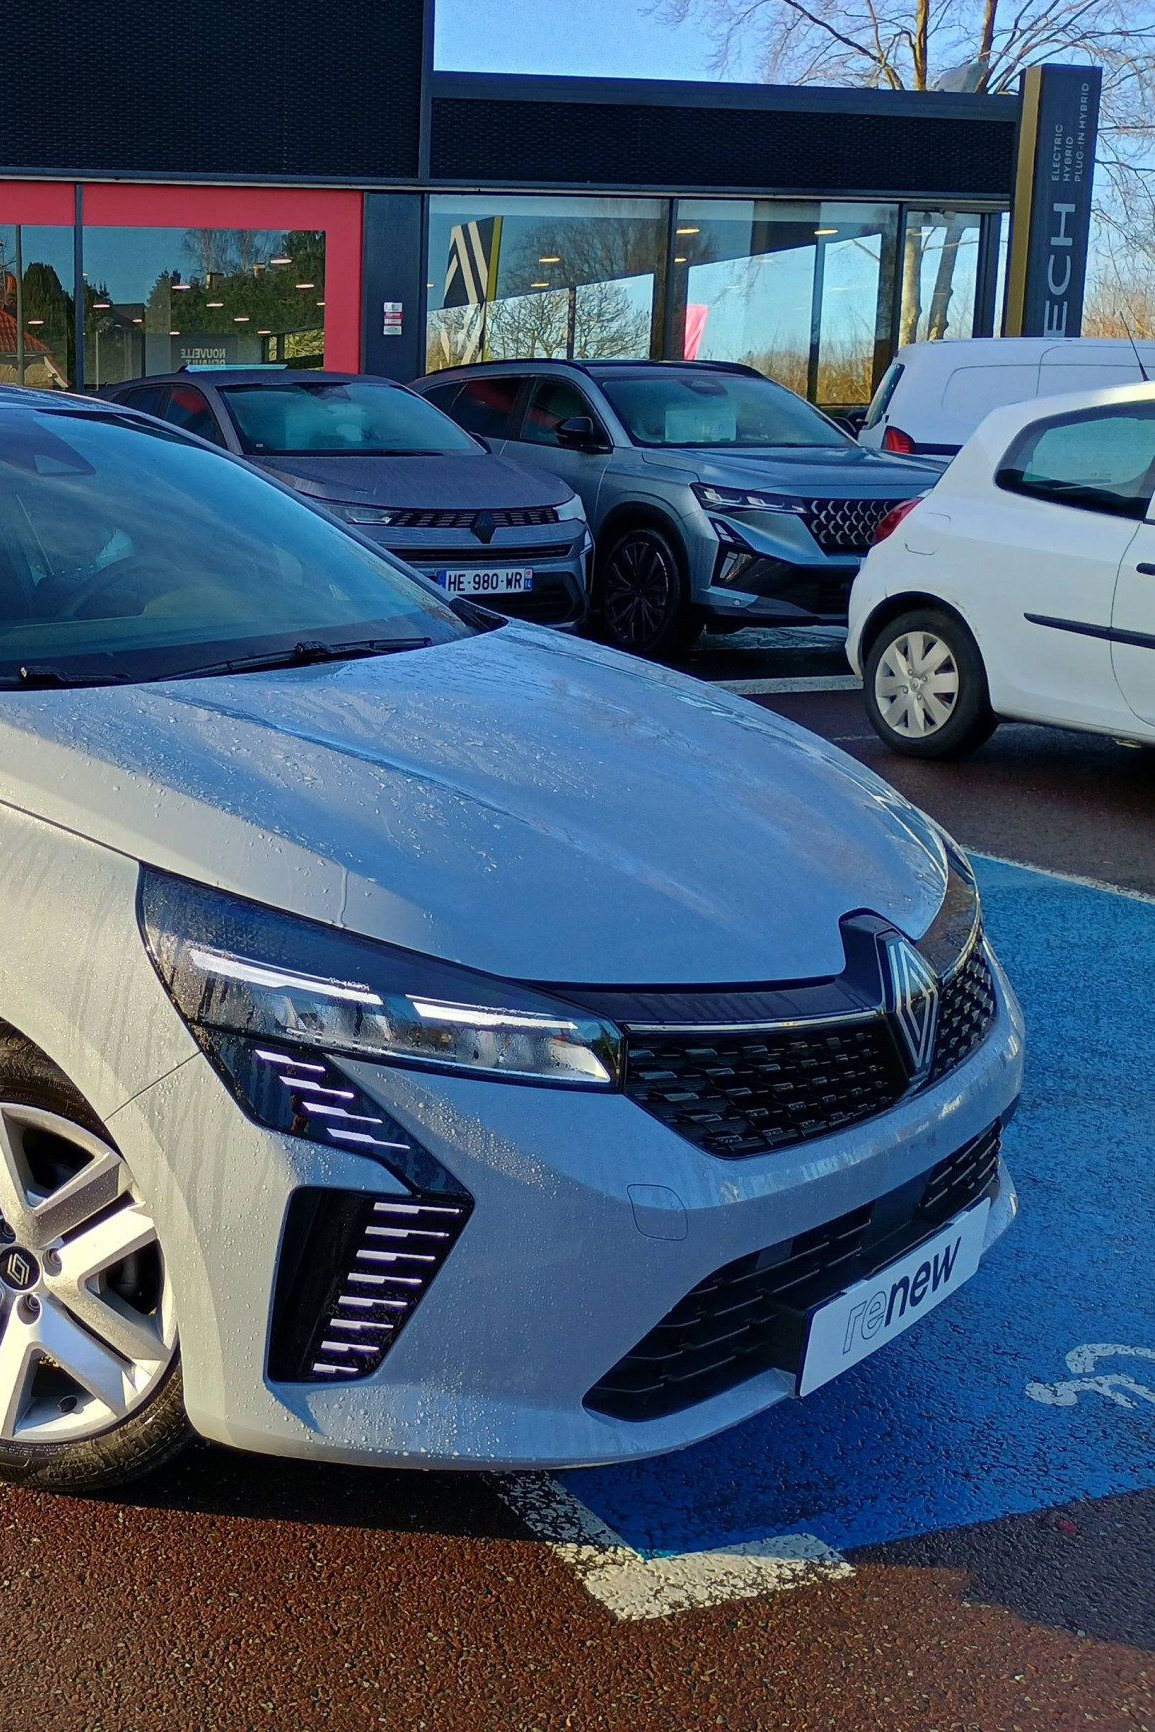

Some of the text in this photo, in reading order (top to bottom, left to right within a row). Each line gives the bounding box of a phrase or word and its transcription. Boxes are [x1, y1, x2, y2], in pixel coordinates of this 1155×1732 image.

[1051, 124, 1064, 181] ELECTRIC
[1063, 136, 1074, 182] HYBRID
[1074, 83, 1090, 182] PLUG-IN HYBRID
[447, 572, 523, 592] HE-980-WR
[842, 1236, 962, 1355] renew
